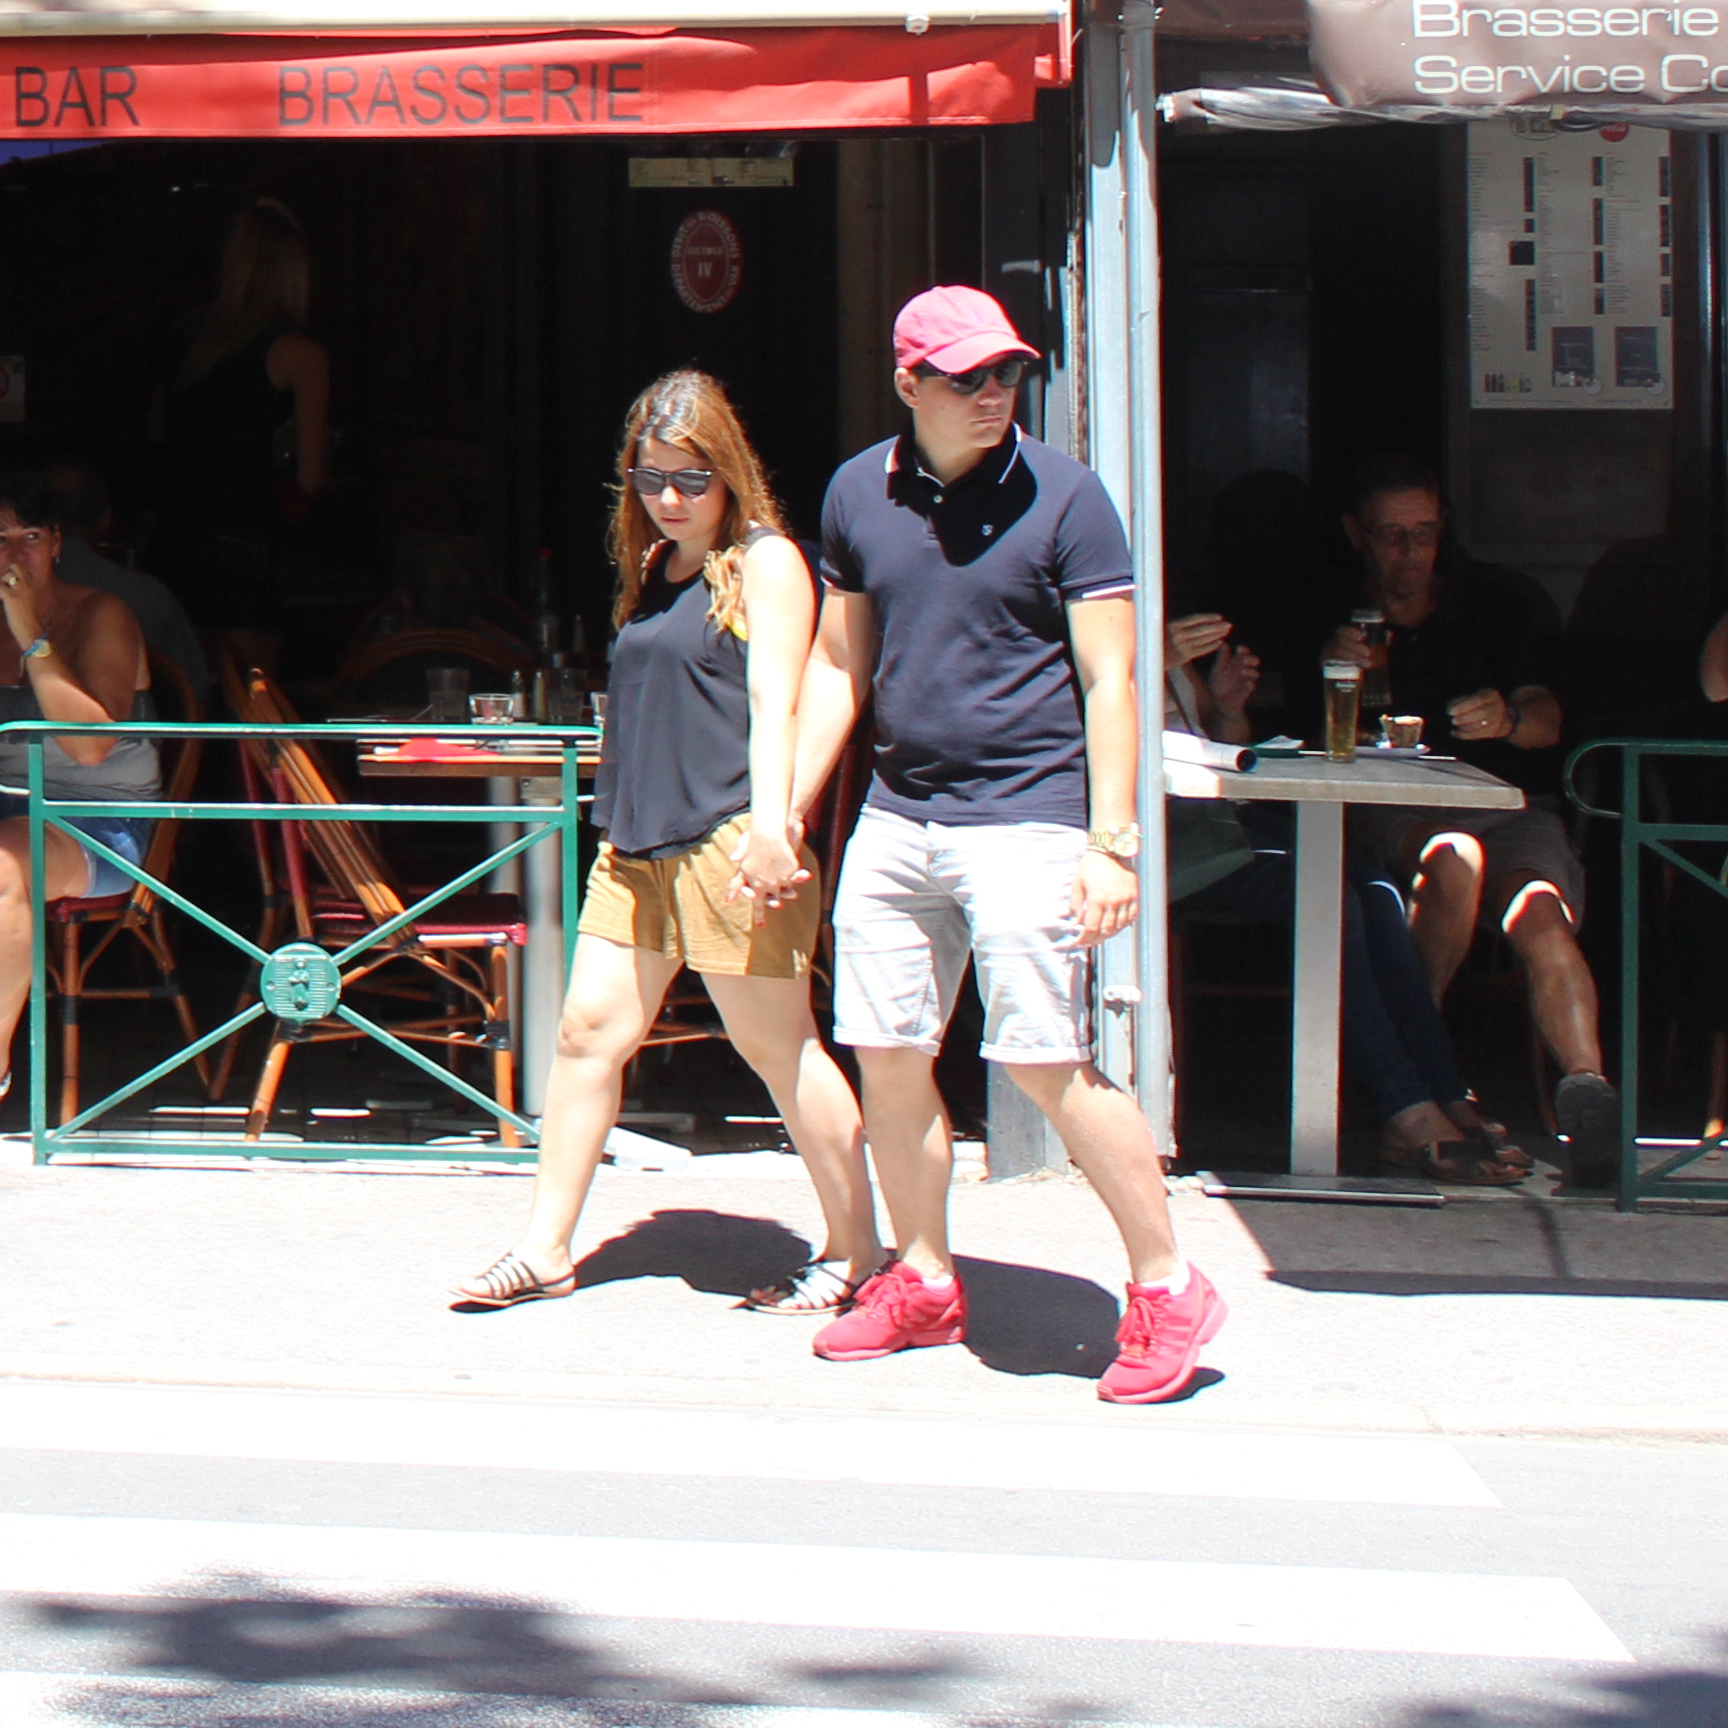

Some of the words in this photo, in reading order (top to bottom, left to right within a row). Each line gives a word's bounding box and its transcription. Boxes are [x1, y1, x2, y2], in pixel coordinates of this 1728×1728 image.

[1414, 54, 1645, 94] Service
[15, 65, 139, 127] BAR
[279, 63, 643, 126] BRASSERIE
[698, 262, 712, 277] IV
